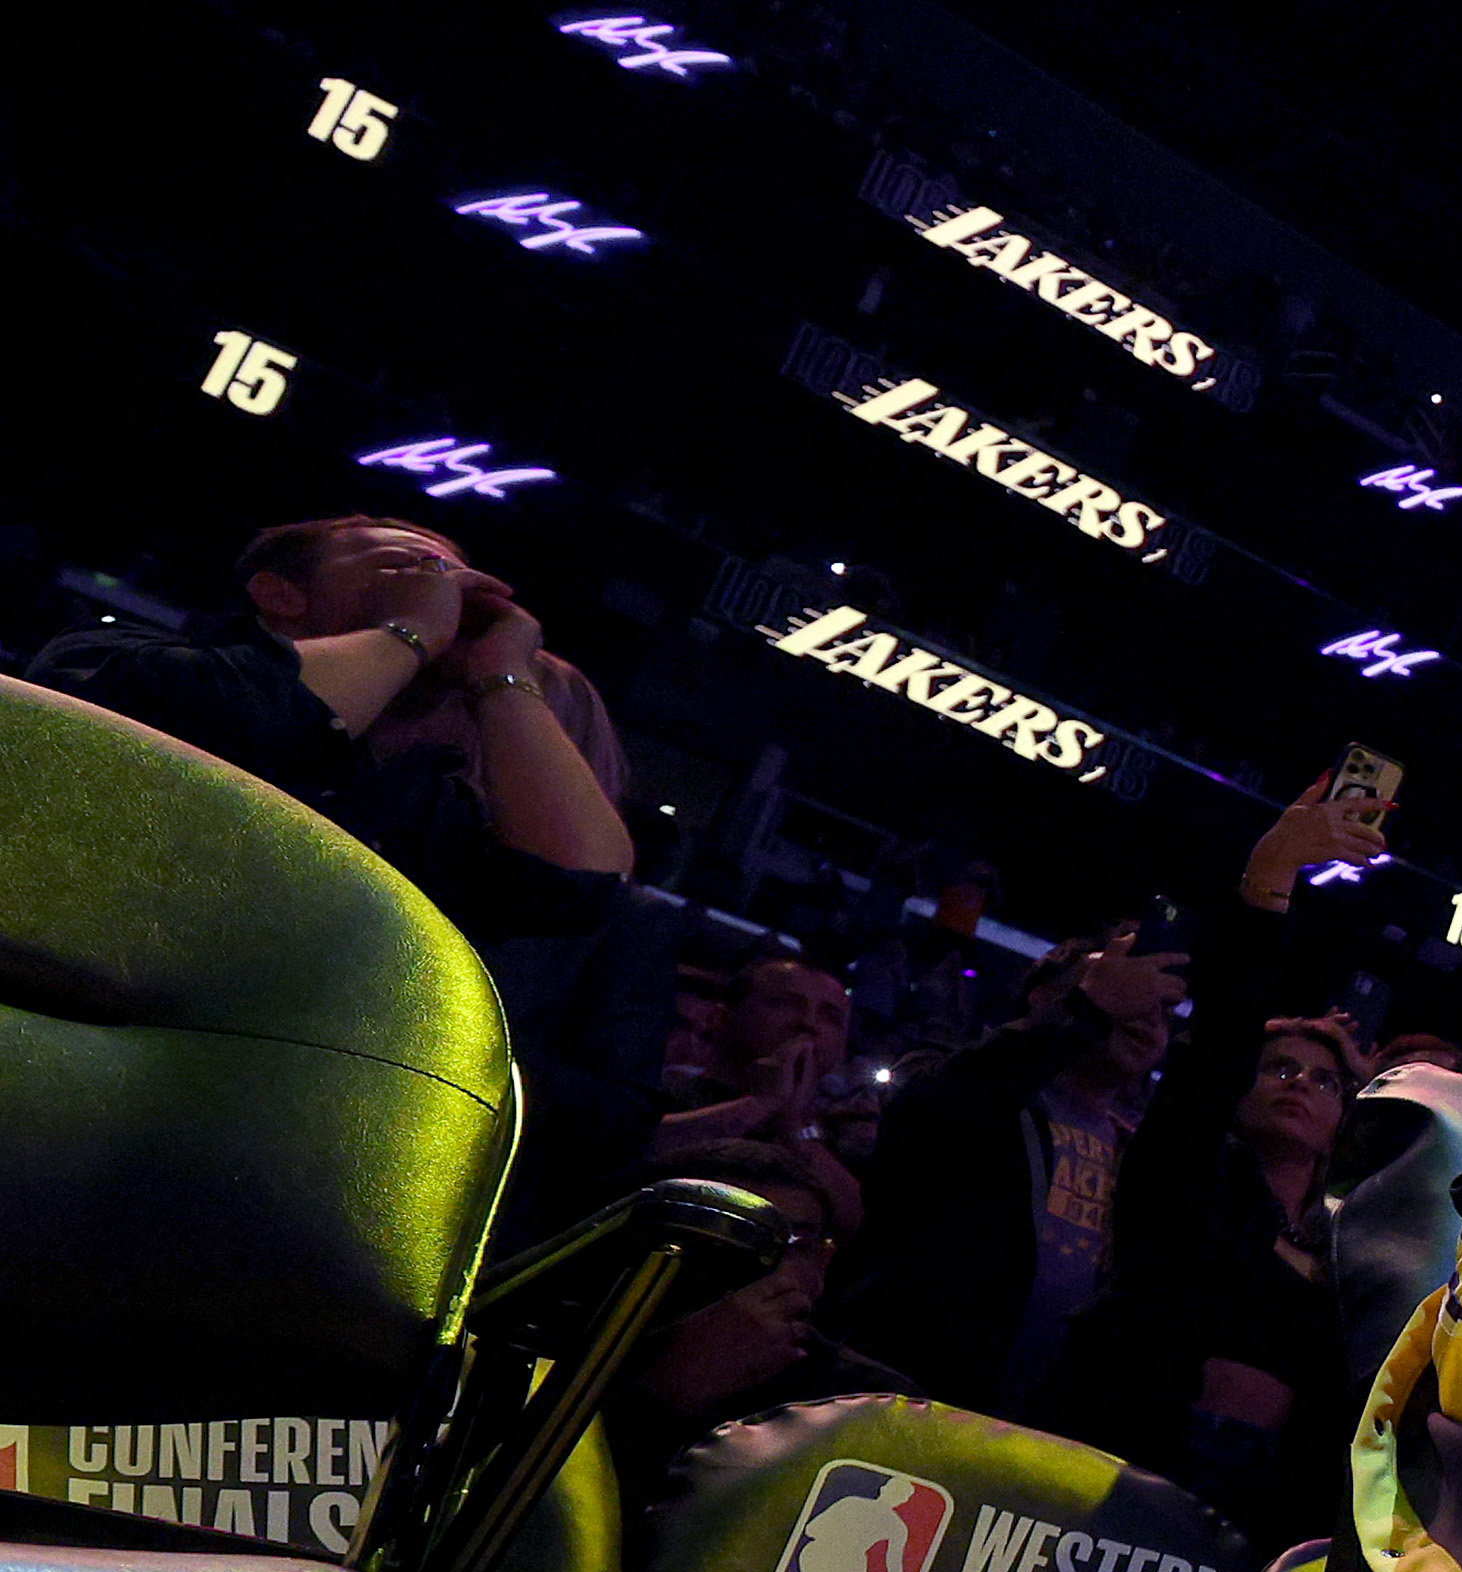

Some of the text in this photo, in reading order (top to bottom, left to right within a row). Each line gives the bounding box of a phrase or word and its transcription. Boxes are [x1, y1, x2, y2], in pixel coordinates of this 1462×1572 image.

[307, 77, 398, 161] 15
[201, 330, 297, 415] 15
[68, 1417, 395, 1486] CONFEREN
